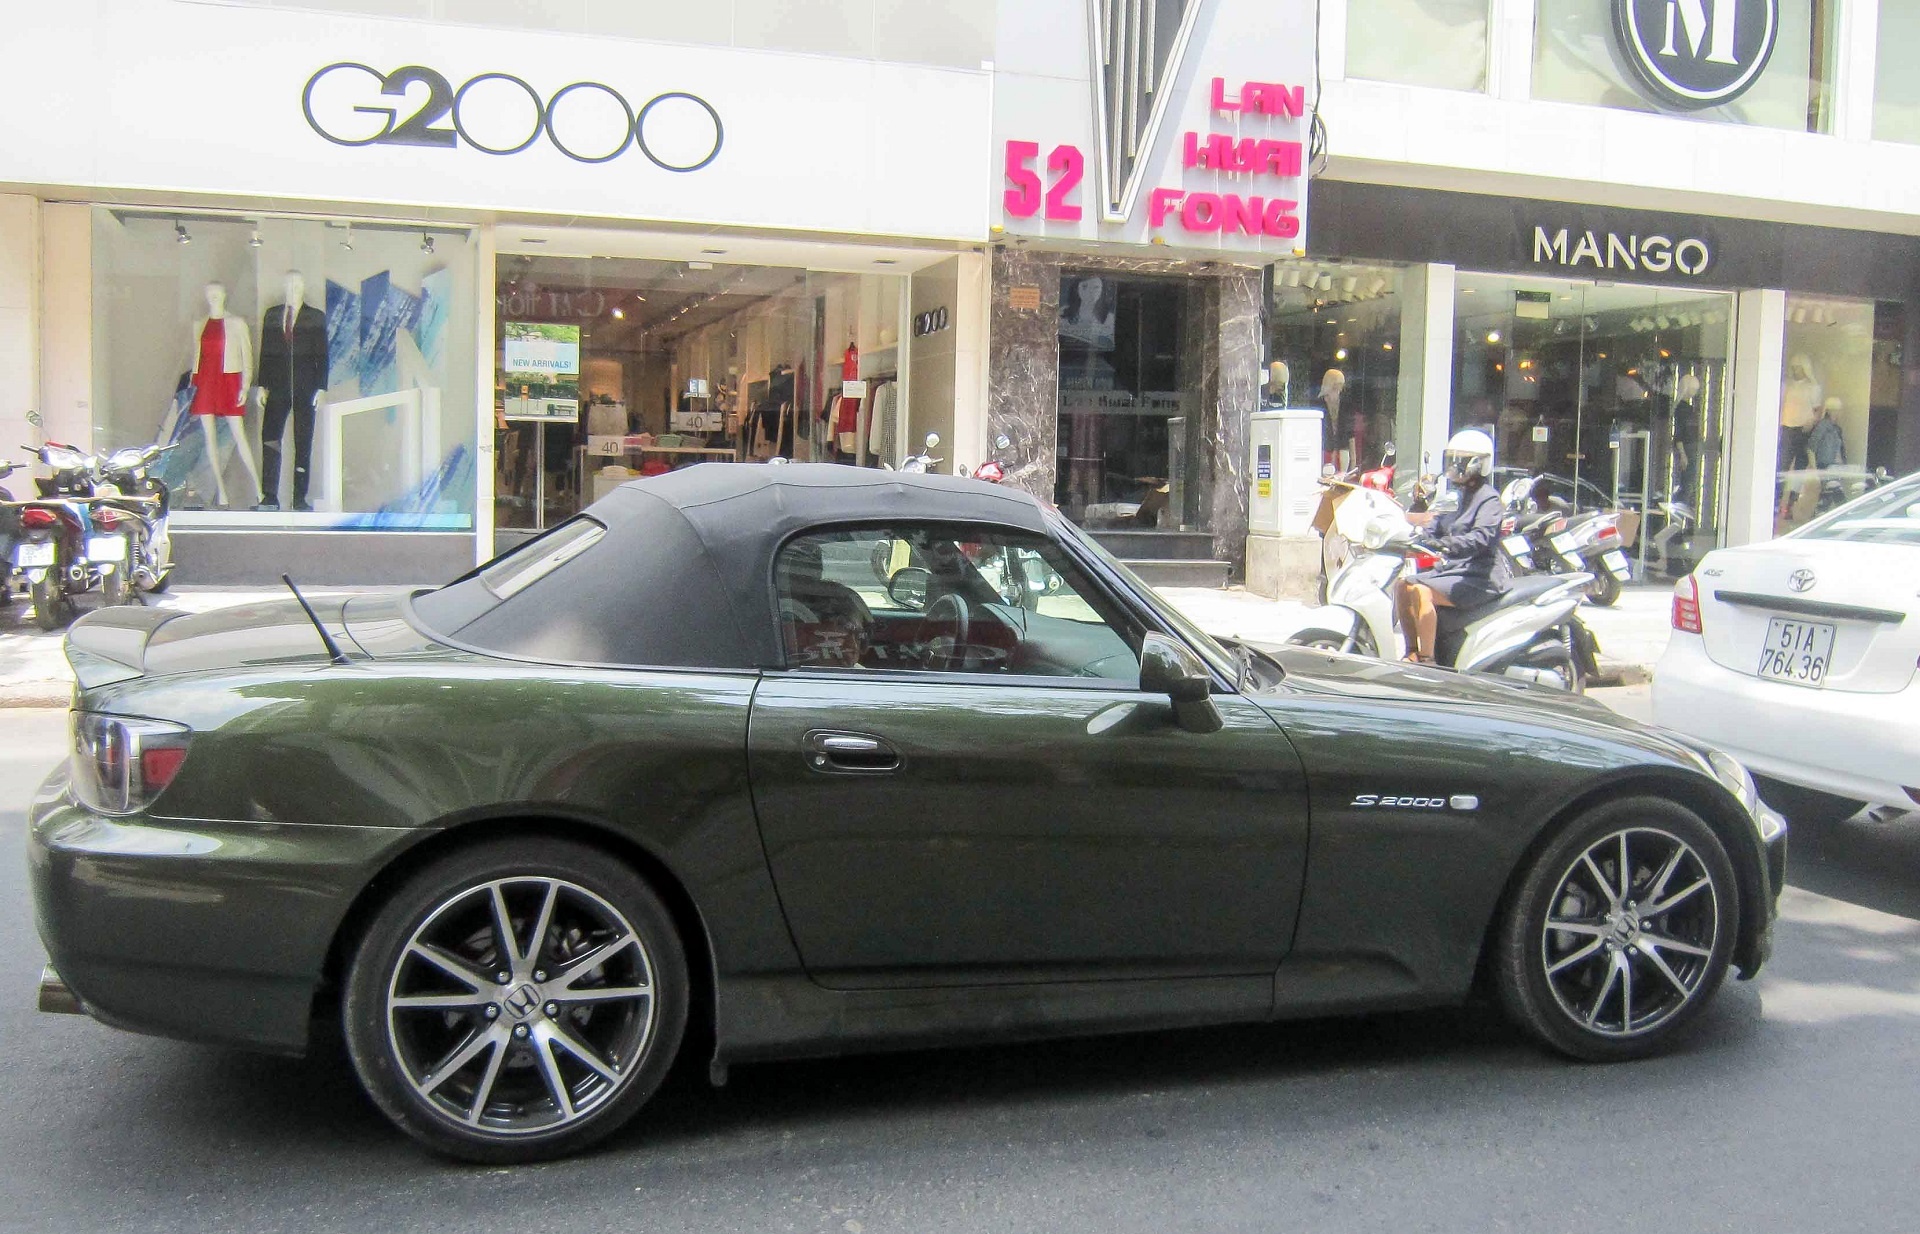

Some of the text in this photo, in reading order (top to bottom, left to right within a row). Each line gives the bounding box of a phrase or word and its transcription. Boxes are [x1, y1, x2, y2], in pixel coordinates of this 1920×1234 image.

[1658, 0, 1739, 65] M
[1210, 77, 1305, 118] LAN
[301, 62, 724, 173] G2000
[1003, 139, 1085, 222] 52
[1150, 187, 1300, 239] FONG
[1533, 226, 1709, 276] MANGO
[512, 358, 572, 370] NEW ARRIVALS!
[685, 416, 703, 428] 40
[601, 441, 619, 454] 40
[1780, 624, 1815, 653] 51A
[1760, 649, 1824, 682] 764.36
[1350, 794, 1446, 808] S2000
